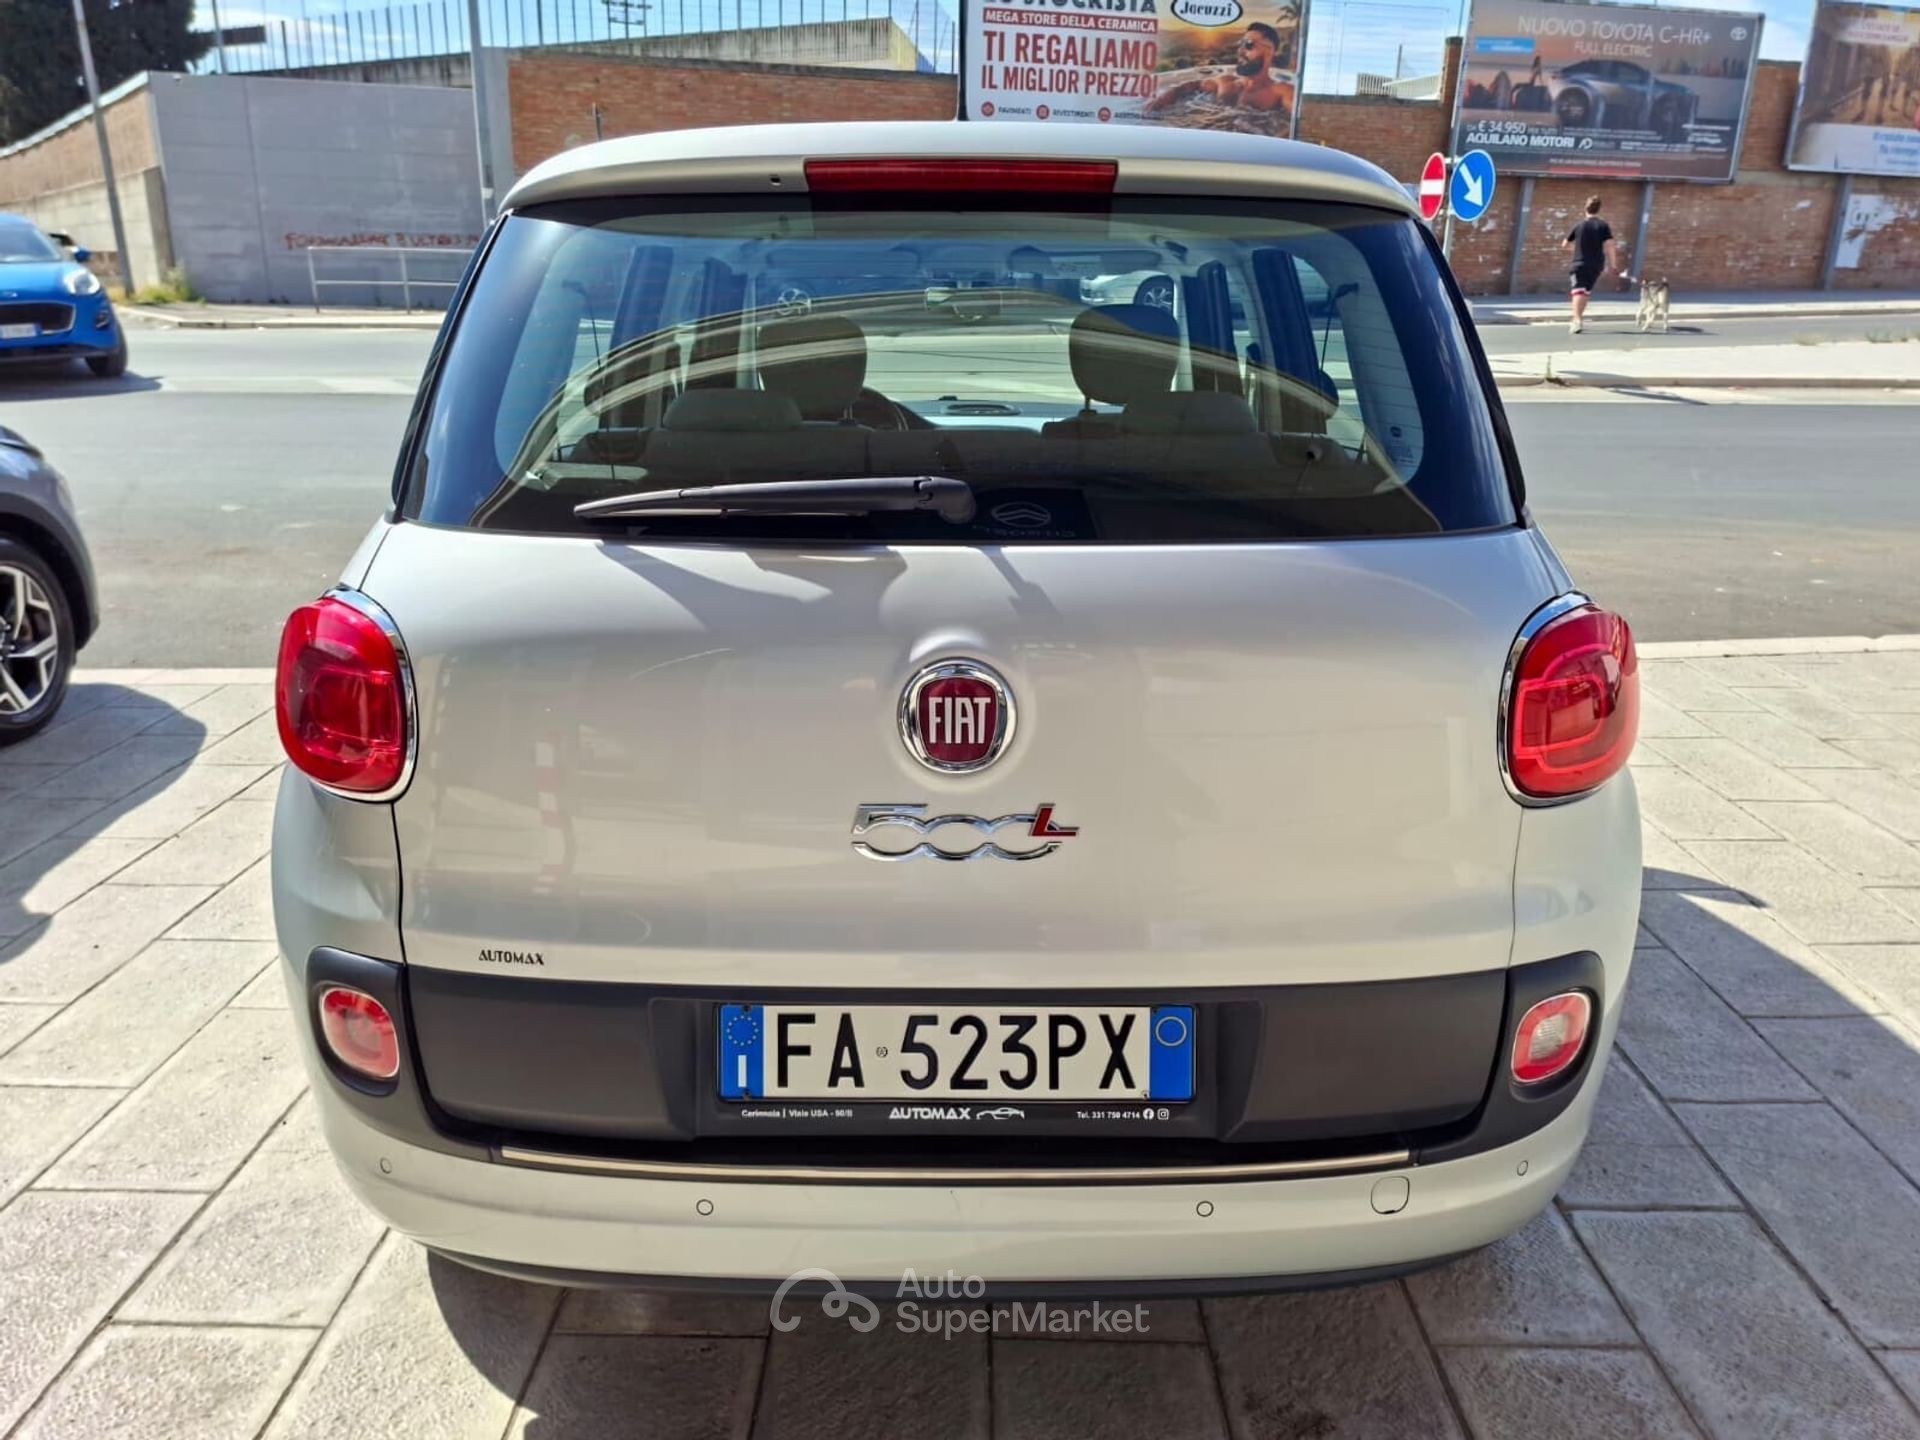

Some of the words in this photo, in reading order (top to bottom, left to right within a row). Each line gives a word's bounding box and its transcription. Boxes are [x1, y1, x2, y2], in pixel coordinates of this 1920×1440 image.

[1180, 1, 1232, 17] Jacuzzi
[985, 9, 1018, 23] MEGA
[1022, 12, 1057, 25] STORE
[1060, 15, 1096, 28] DELLA
[1098, 18, 1156, 32] CERAMICA
[1517, 15, 1586, 37] NUOVO
[1590, 19, 1653, 41] TOYOTA
[1659, 25, 1713, 45] C-HR+
[983, 31, 1004, 62] TI
[1015, 32, 1158, 69] REGALIAMO
[1574, 39, 1600, 56] FULL
[1602, 42, 1653, 57] ELECTRIC
[981, 65, 998, 89] IL
[1003, 66, 1079, 93] MIGLIOR
[1084, 70, 1158, 98] PREZZO!
[1465, 132, 1528, 146] AQUILANO
[1529, 135, 1575, 148] MOTORI
[928, 697, 991, 744] FIAT
[851, 803, 1080, 862] 500L
[478, 949, 544, 966] AUTOMAX
[777, 1013, 865, 1088] FA
[901, 1014, 1136, 1090] 523PX
[810, 1108, 829, 1118] USA
[889, 1107, 971, 1119] AUTOMAX
[1077, 1111, 1090, 1119] Tel.
[1092, 1111, 1105, 1119] 331
[1122, 1111, 1140, 1119] 4714
